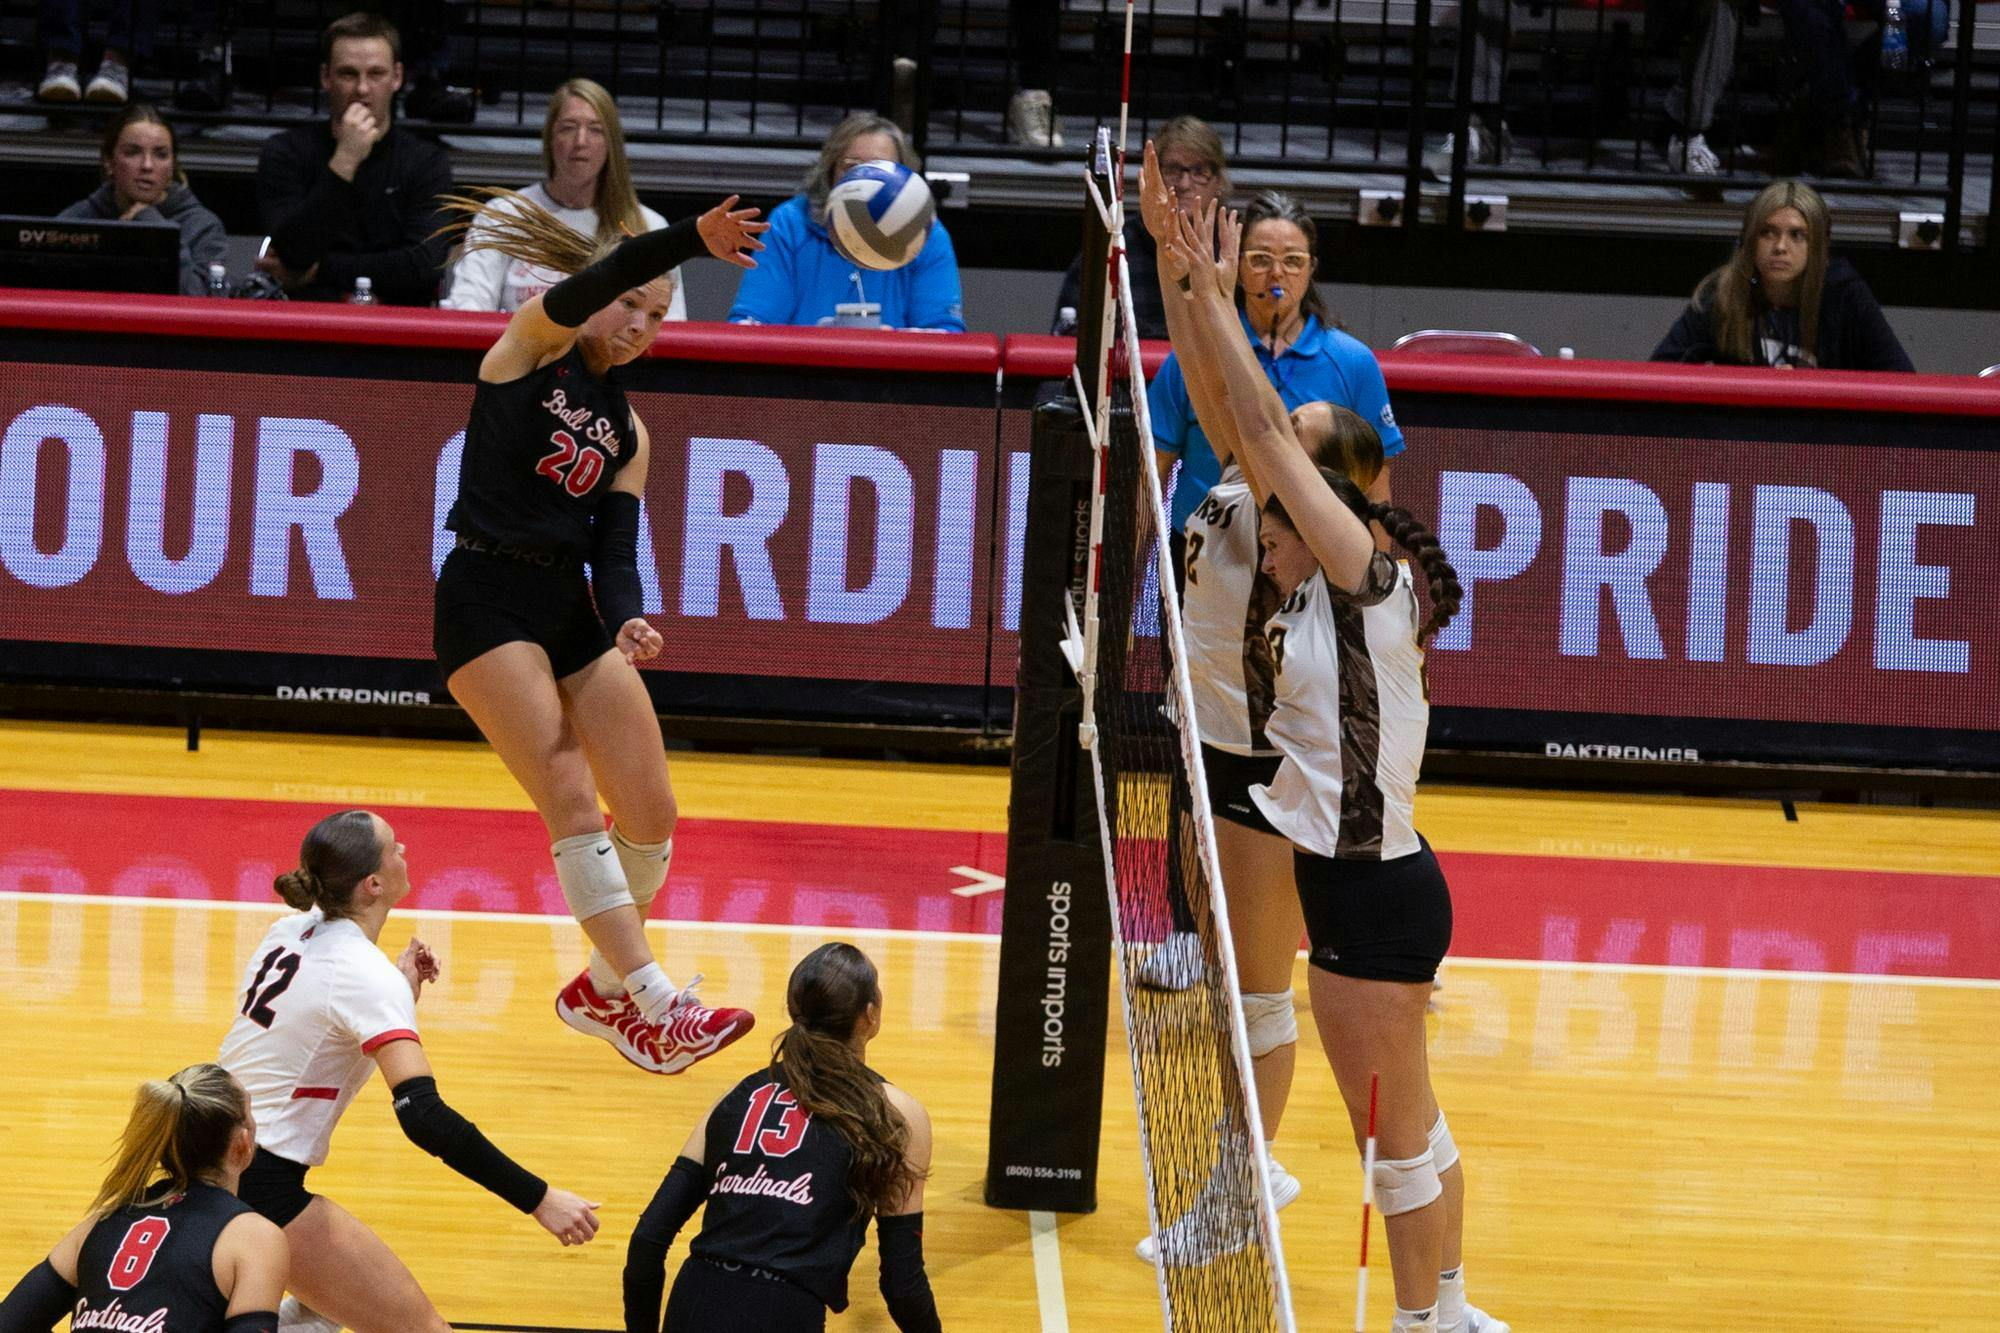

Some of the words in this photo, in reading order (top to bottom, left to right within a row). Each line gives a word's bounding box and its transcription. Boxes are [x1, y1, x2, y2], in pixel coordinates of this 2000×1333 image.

[542, 388, 593, 431] Ball
[535, 430, 605, 498] 20
[0, 402, 360, 601] OUR
[1432, 470, 1976, 674] PRIDE
[276, 685, 431, 705] DAKTRONICS
[1545, 742, 1699, 763] DAKTRONICS
[1046, 881, 1072, 963] sports
[241, 945, 302, 1030] 12
[1040, 967, 1067, 1067] imports
[733, 1082, 810, 1158] 13
[709, 1161, 815, 1206] Cardinals
[1005, 1165, 1032, 1178] (800)
[1034, 1167, 1082, 1180] 556-3198
[107, 1215, 171, 1291] 8
[71, 1296, 169, 1333] Cardinals
